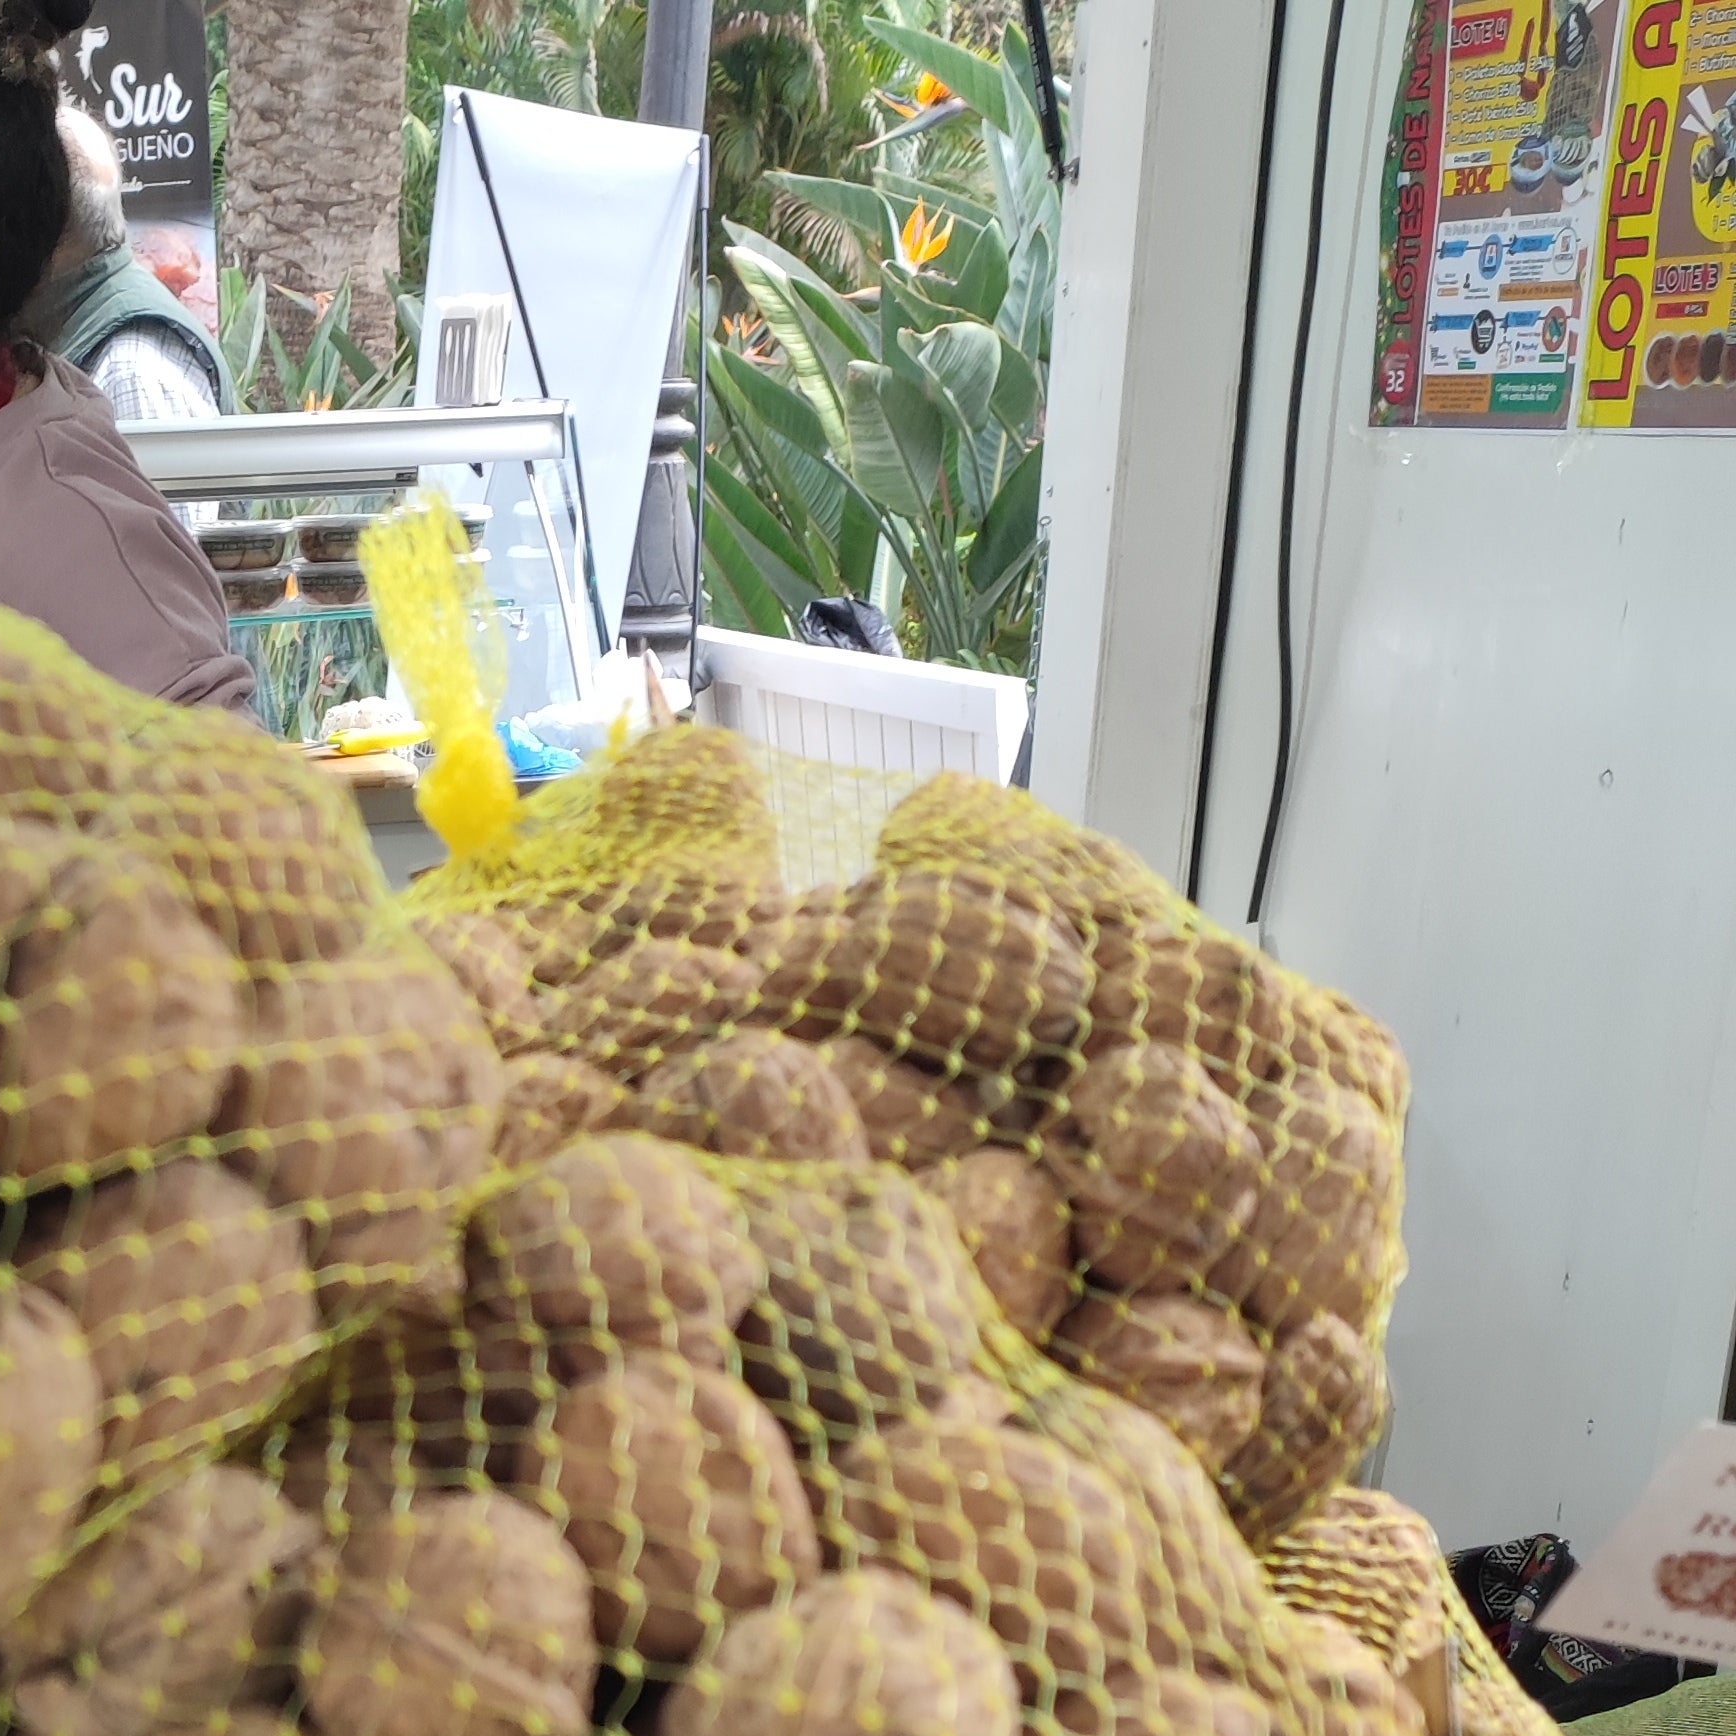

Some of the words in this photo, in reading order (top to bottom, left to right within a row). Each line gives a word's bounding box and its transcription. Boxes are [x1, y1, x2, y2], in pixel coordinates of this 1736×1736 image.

[1451, 19, 1495, 48] LOTE
[105, 63, 192, 128] Sur
[1402, 110, 1428, 173] DE
[1390, 181, 1424, 325] LOTES
[1588, 96, 1668, 401] LOTES
[1654, 263, 1702, 294] LOTE
[1705, 262, 1721, 291] 3
[1386, 370, 1405, 393] 32
